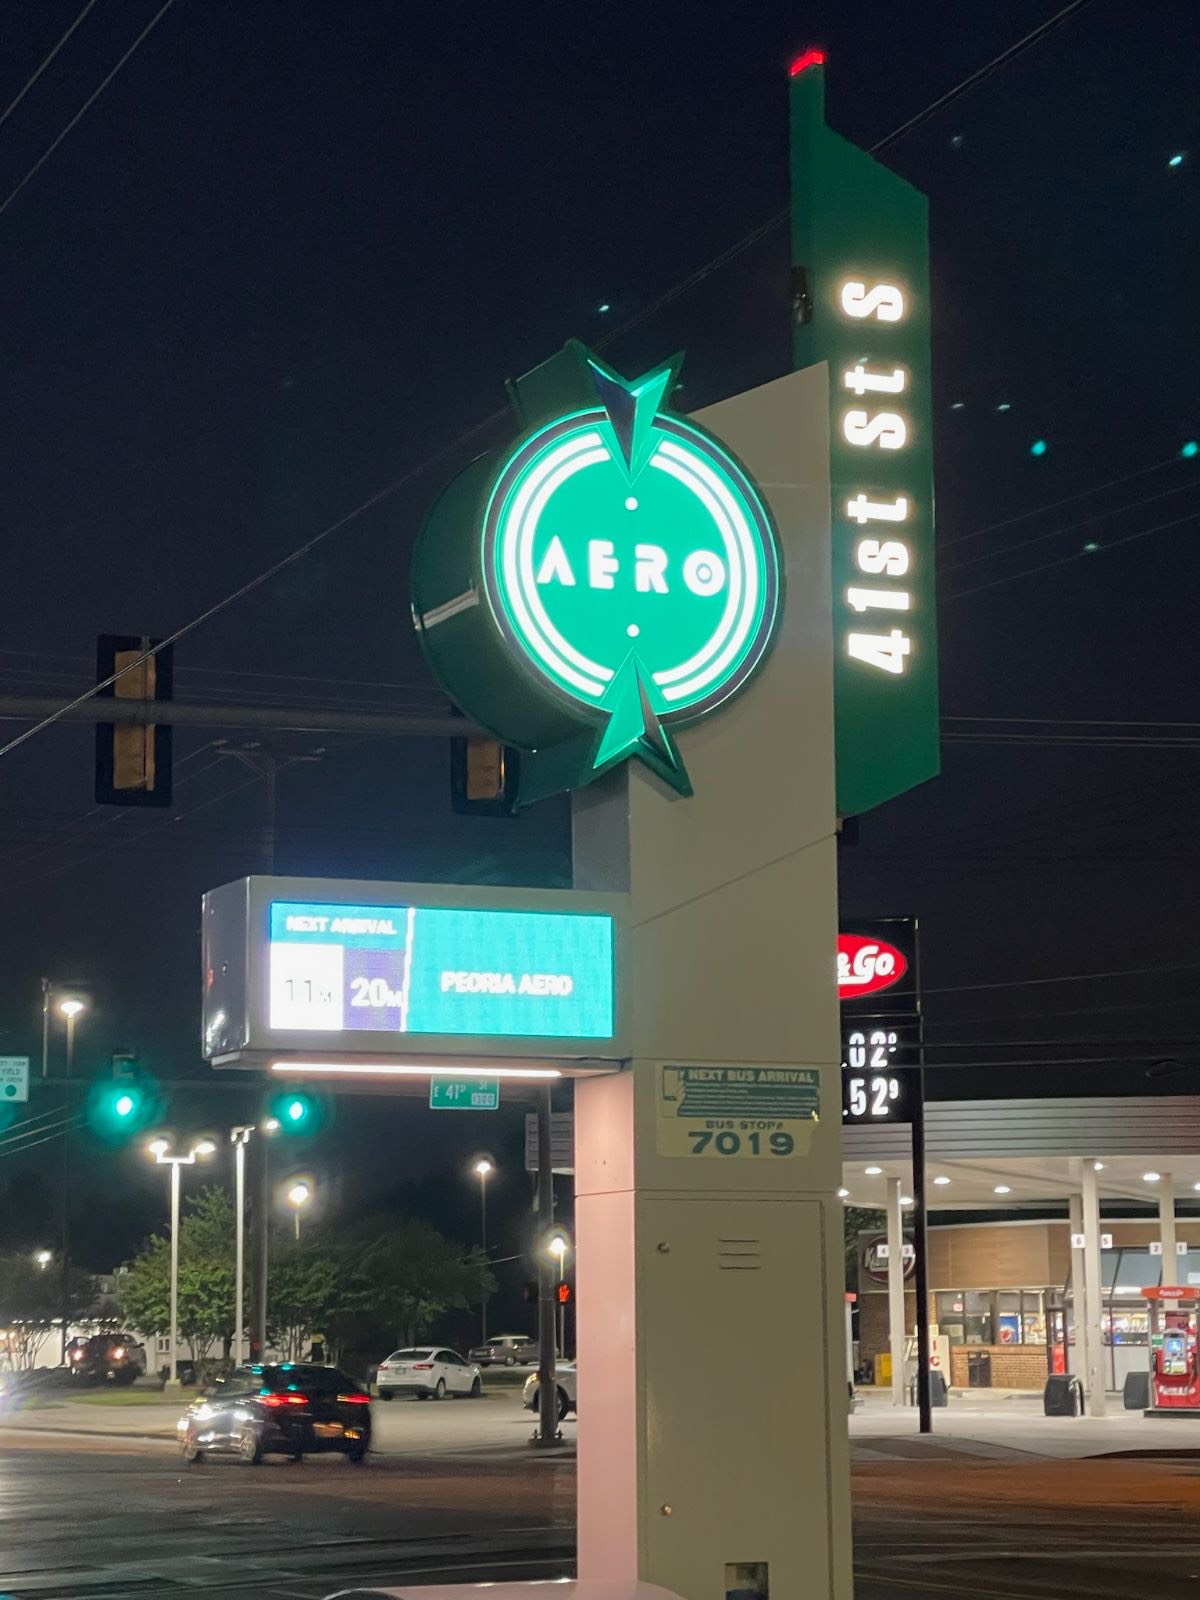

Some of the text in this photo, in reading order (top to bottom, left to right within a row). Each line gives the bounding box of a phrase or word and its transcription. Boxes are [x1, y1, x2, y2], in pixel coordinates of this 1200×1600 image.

[841, 281, 910, 674] 41st St S
[536, 534, 726, 597] AERO
[286, 916, 398, 935] NEXT ARRIVAL
[441, 971, 573, 996] PEORIA AERO
[688, 1069, 814, 1083] NEXT BUS ARRIVAL
[706, 1120, 784, 1130] BUS STOP#
[687, 1131, 795, 1156] 7019
